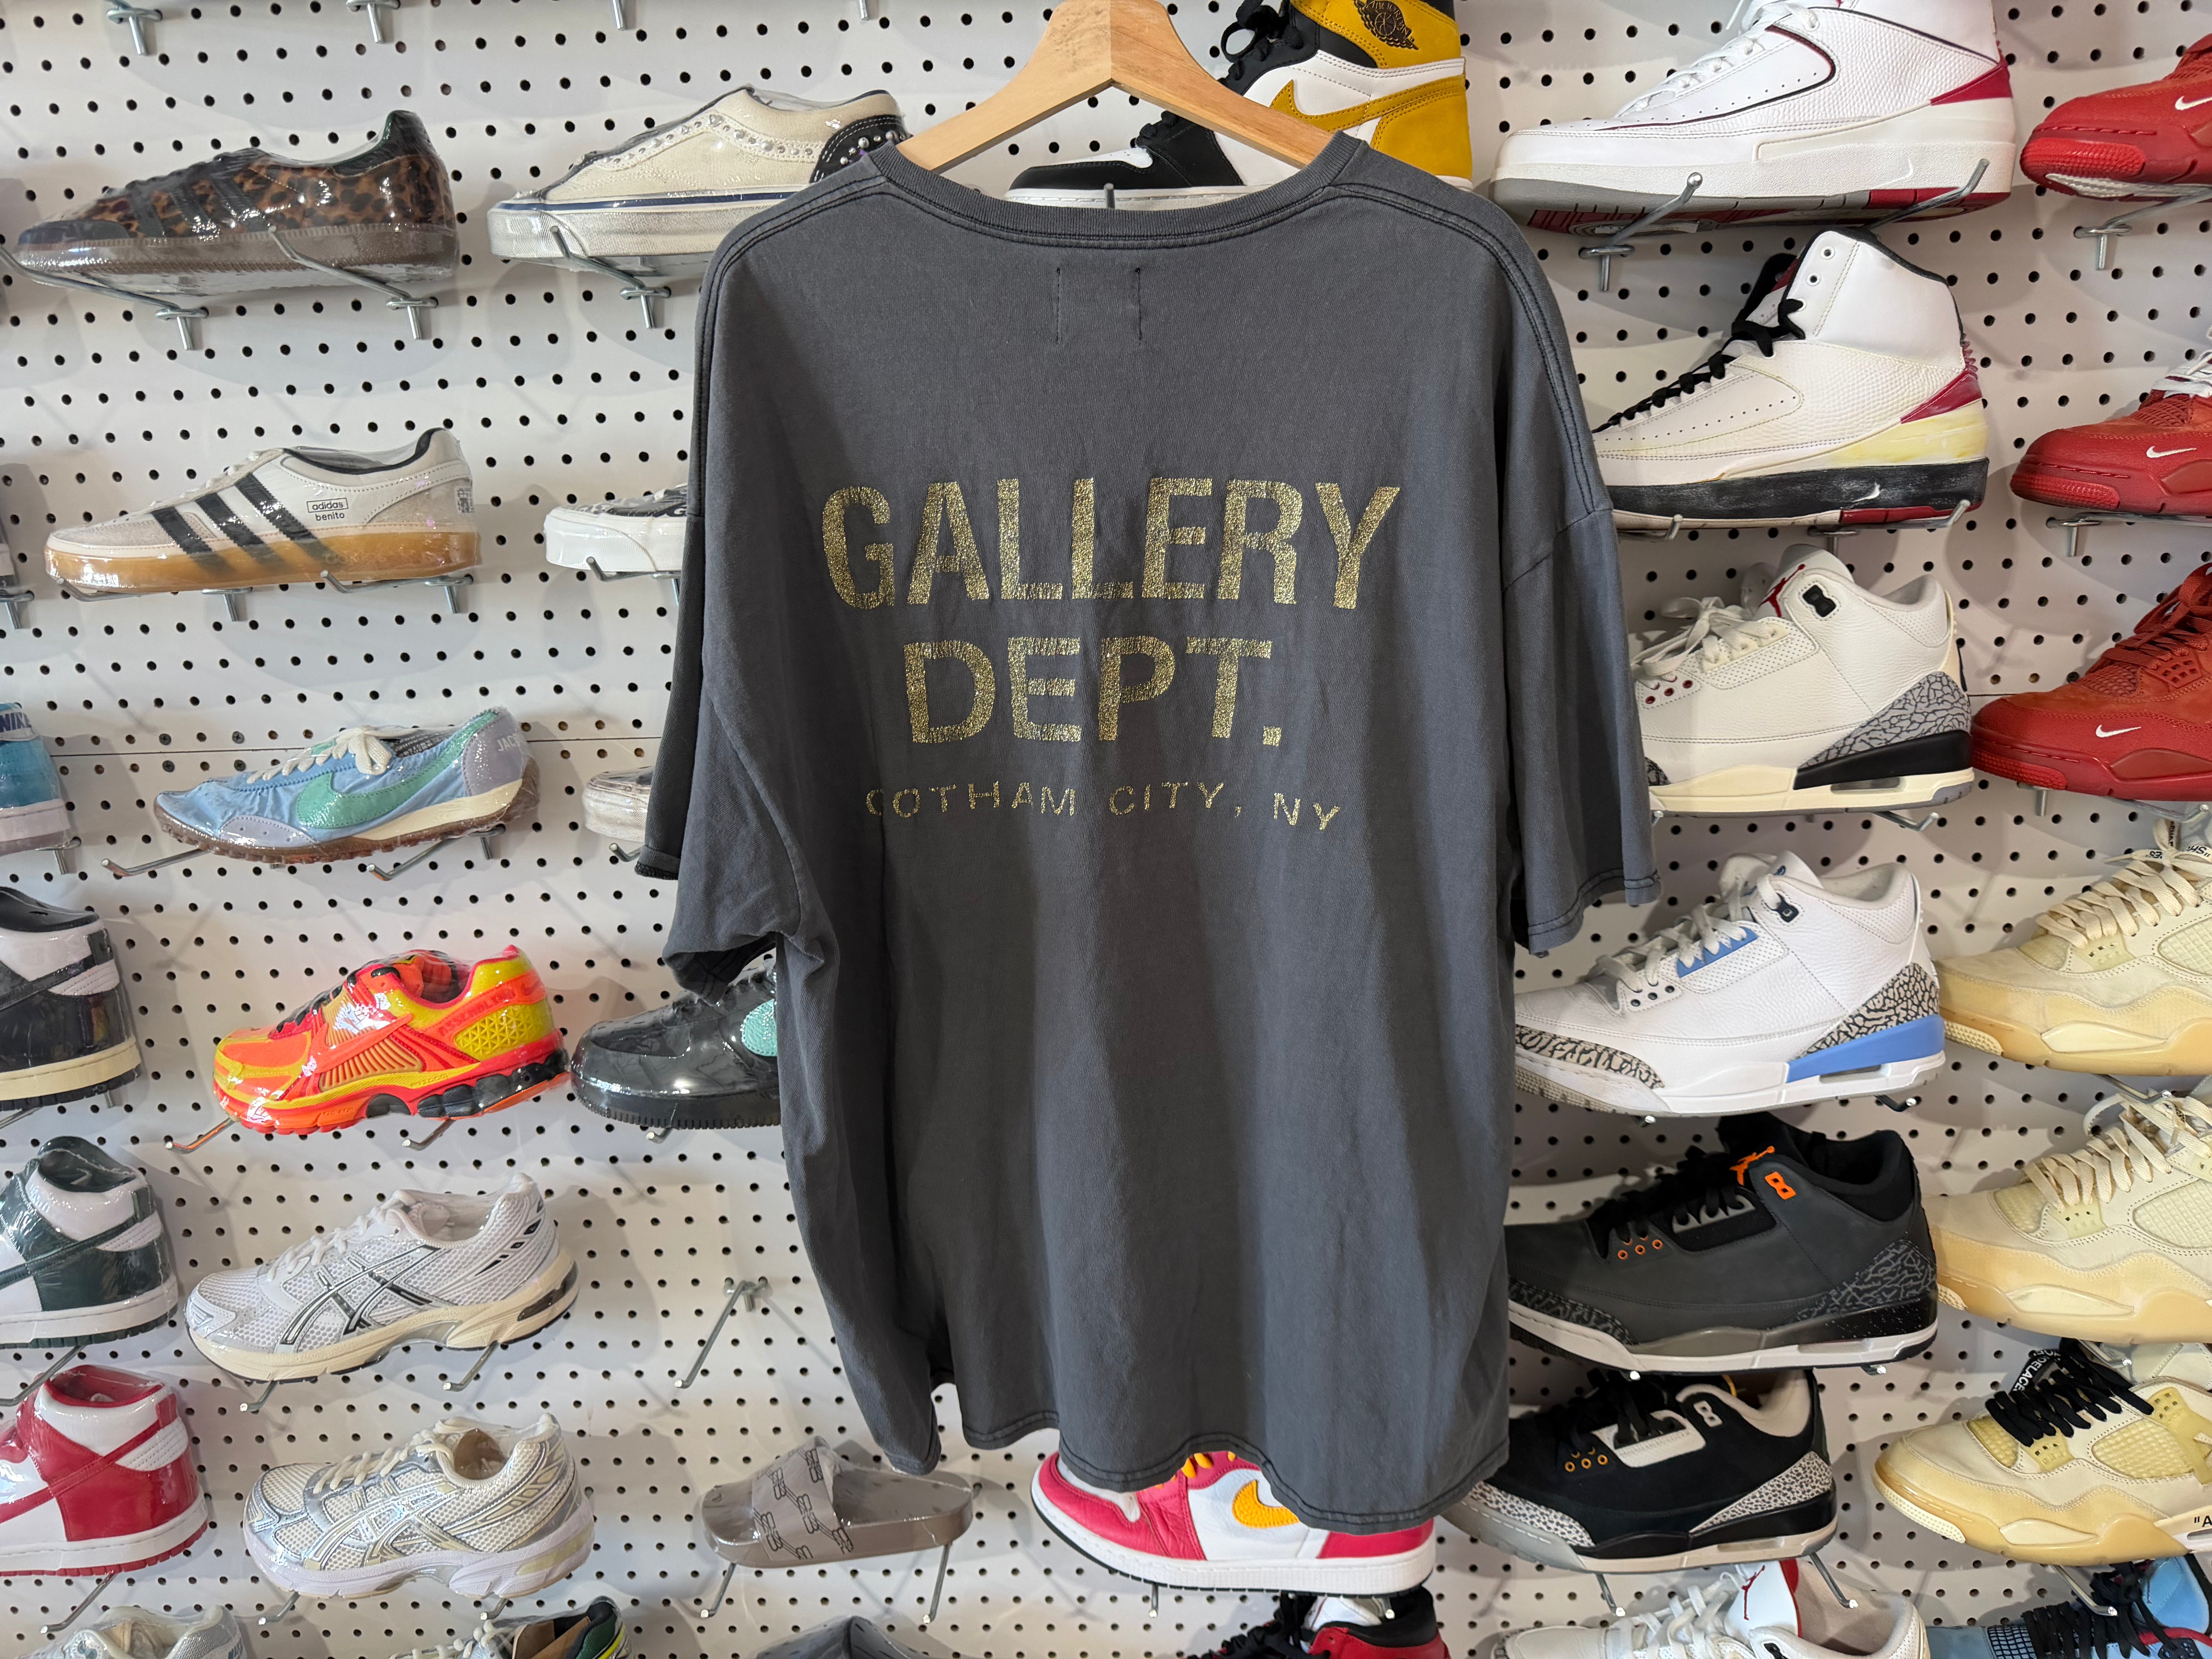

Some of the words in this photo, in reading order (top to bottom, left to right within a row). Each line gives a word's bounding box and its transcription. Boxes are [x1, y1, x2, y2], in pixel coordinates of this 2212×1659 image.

[312, 501, 343, 510] adidas
[315, 512, 345, 521] benito
[822, 477, 1401, 610] GALLERY
[904, 635, 1282, 746] DEPT.
[1109, 782, 1242, 817] CITY,
[1274, 793, 1340, 831] NY
